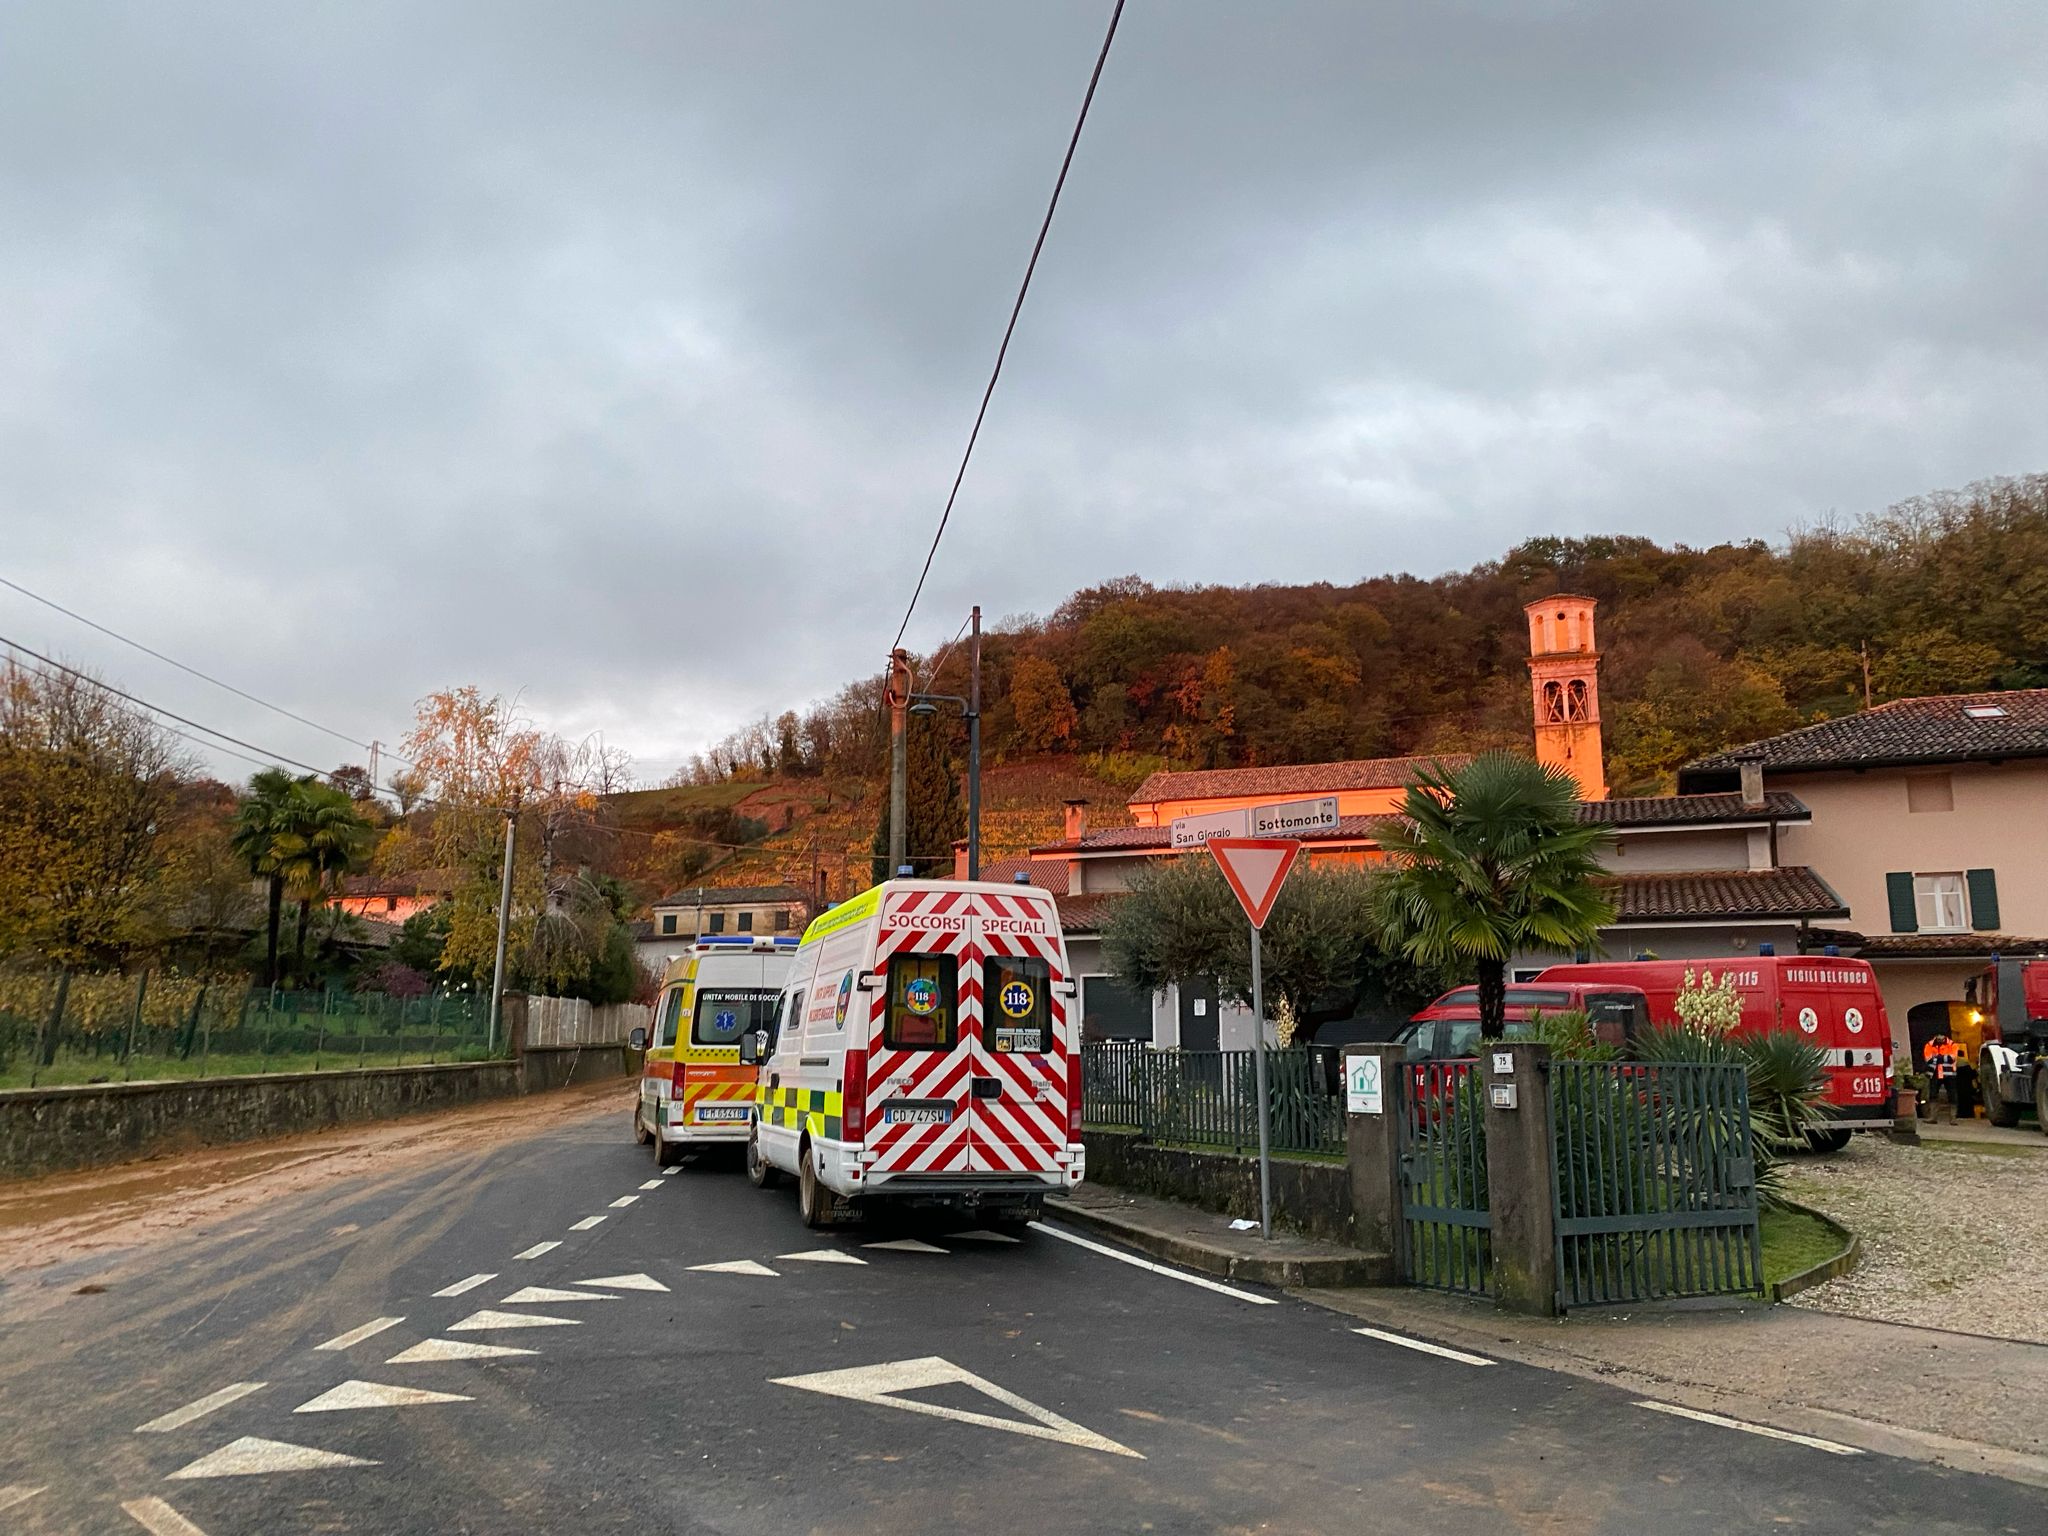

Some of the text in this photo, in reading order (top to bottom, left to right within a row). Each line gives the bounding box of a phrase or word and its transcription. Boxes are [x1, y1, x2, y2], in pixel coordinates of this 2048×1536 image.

[1175, 822, 1186, 830] via
[1258, 812, 1333, 831] Sottomonte
[1176, 834, 1194, 844] San
[888, 914, 966, 931] SOCCORSI
[981, 919, 1046, 934] SPECIALI
[1738, 971, 1759, 986] 115
[1787, 969, 1868, 984] VIGILI DEL FUOCO
[724, 993, 748, 1001] MOBILE
[749, 993, 757, 1001] DI
[915, 992, 929, 1001] 118
[1006, 992, 1027, 1006] 118
[1498, 1056, 1507, 1066] 75
[1864, 1077, 1881, 1093] 115
[893, 1110, 944, 1122] CD 747SW
